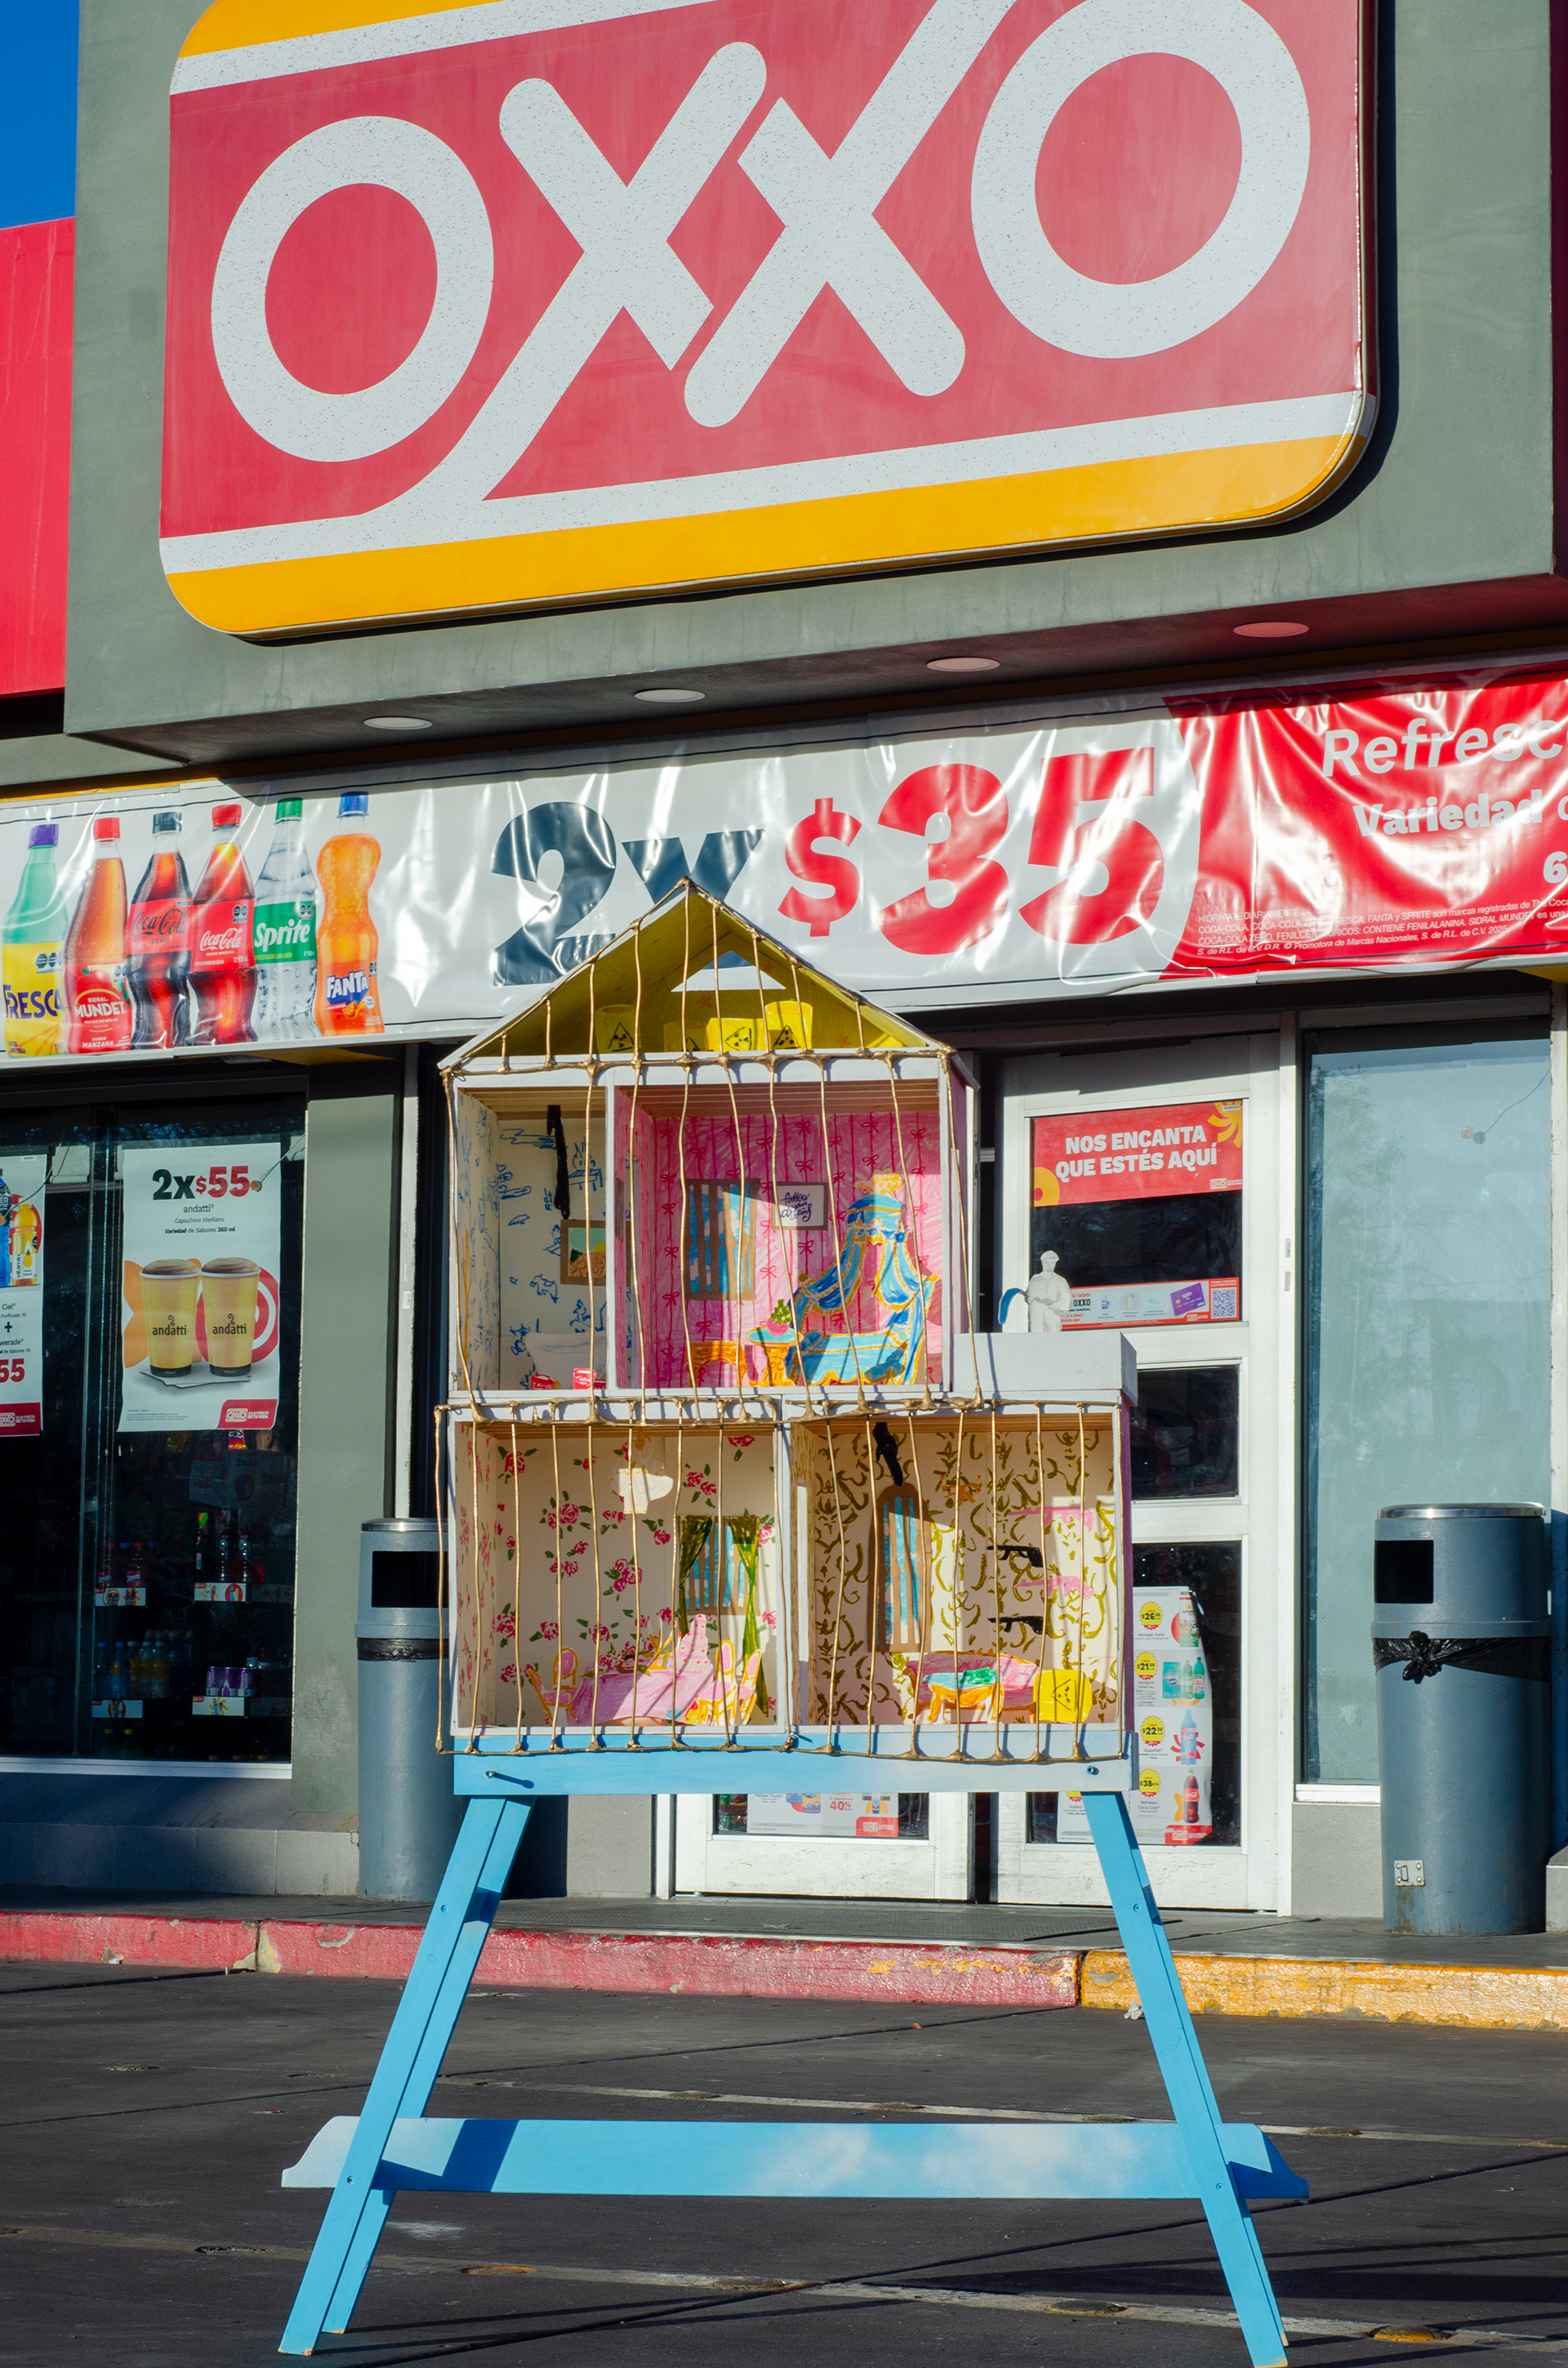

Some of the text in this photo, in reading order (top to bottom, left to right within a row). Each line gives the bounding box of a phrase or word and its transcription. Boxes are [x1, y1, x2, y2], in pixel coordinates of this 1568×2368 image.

[211, 0, 1312, 506] OXXO
[1322, 717, 1568, 777] Refresc
[1352, 789, 1544, 837] Variedad
[131, 908, 189, 938] Coca-Cola
[1368, 912, 1394, 923] FANTA
[1395, 914, 1401, 923] y
[1401, 909, 1431, 921] SPRITE
[1432, 910, 1448, 919] son
[1448, 908, 1477, 917] marcas
[1477, 902, 1519, 915] registradas
[1520, 901, 1531, 909] de
[200, 927, 243, 952] Coca-Cola
[254, 918, 311, 952] Sprite
[1198, 934, 1249, 946] COCA-COLA
[1362, 923, 1405, 934] CONTIENE
[1468, 915, 1498, 926] SIDRAL
[1236, 946, 1247, 954] de
[1294, 940, 1334, 950] Promotora
[1334, 939, 1345, 947] de
[1346, 937, 1374, 946] Marcas
[1431, 930, 1442, 939] de
[1459, 929, 1471, 938] de
[327, 970, 368, 998] FANTA
[74, 1001, 125, 1018] MUNDET
[82, 1040, 114, 1048] MANZANA
[1065, 1125, 1206, 1154] NOS ENCANTA
[1055, 1142, 1217, 1183] QUE ESTÉS AQUÍ
[780, 1192, 810, 1206] follow
[781, 1202, 812, 1222] dreams
[1073, 1298, 1091, 1307] OXXO
[152, 1324, 187, 1336] andatti
[212, 1323, 247, 1335] andatti
[226, 1410, 247, 1420] OXXO
